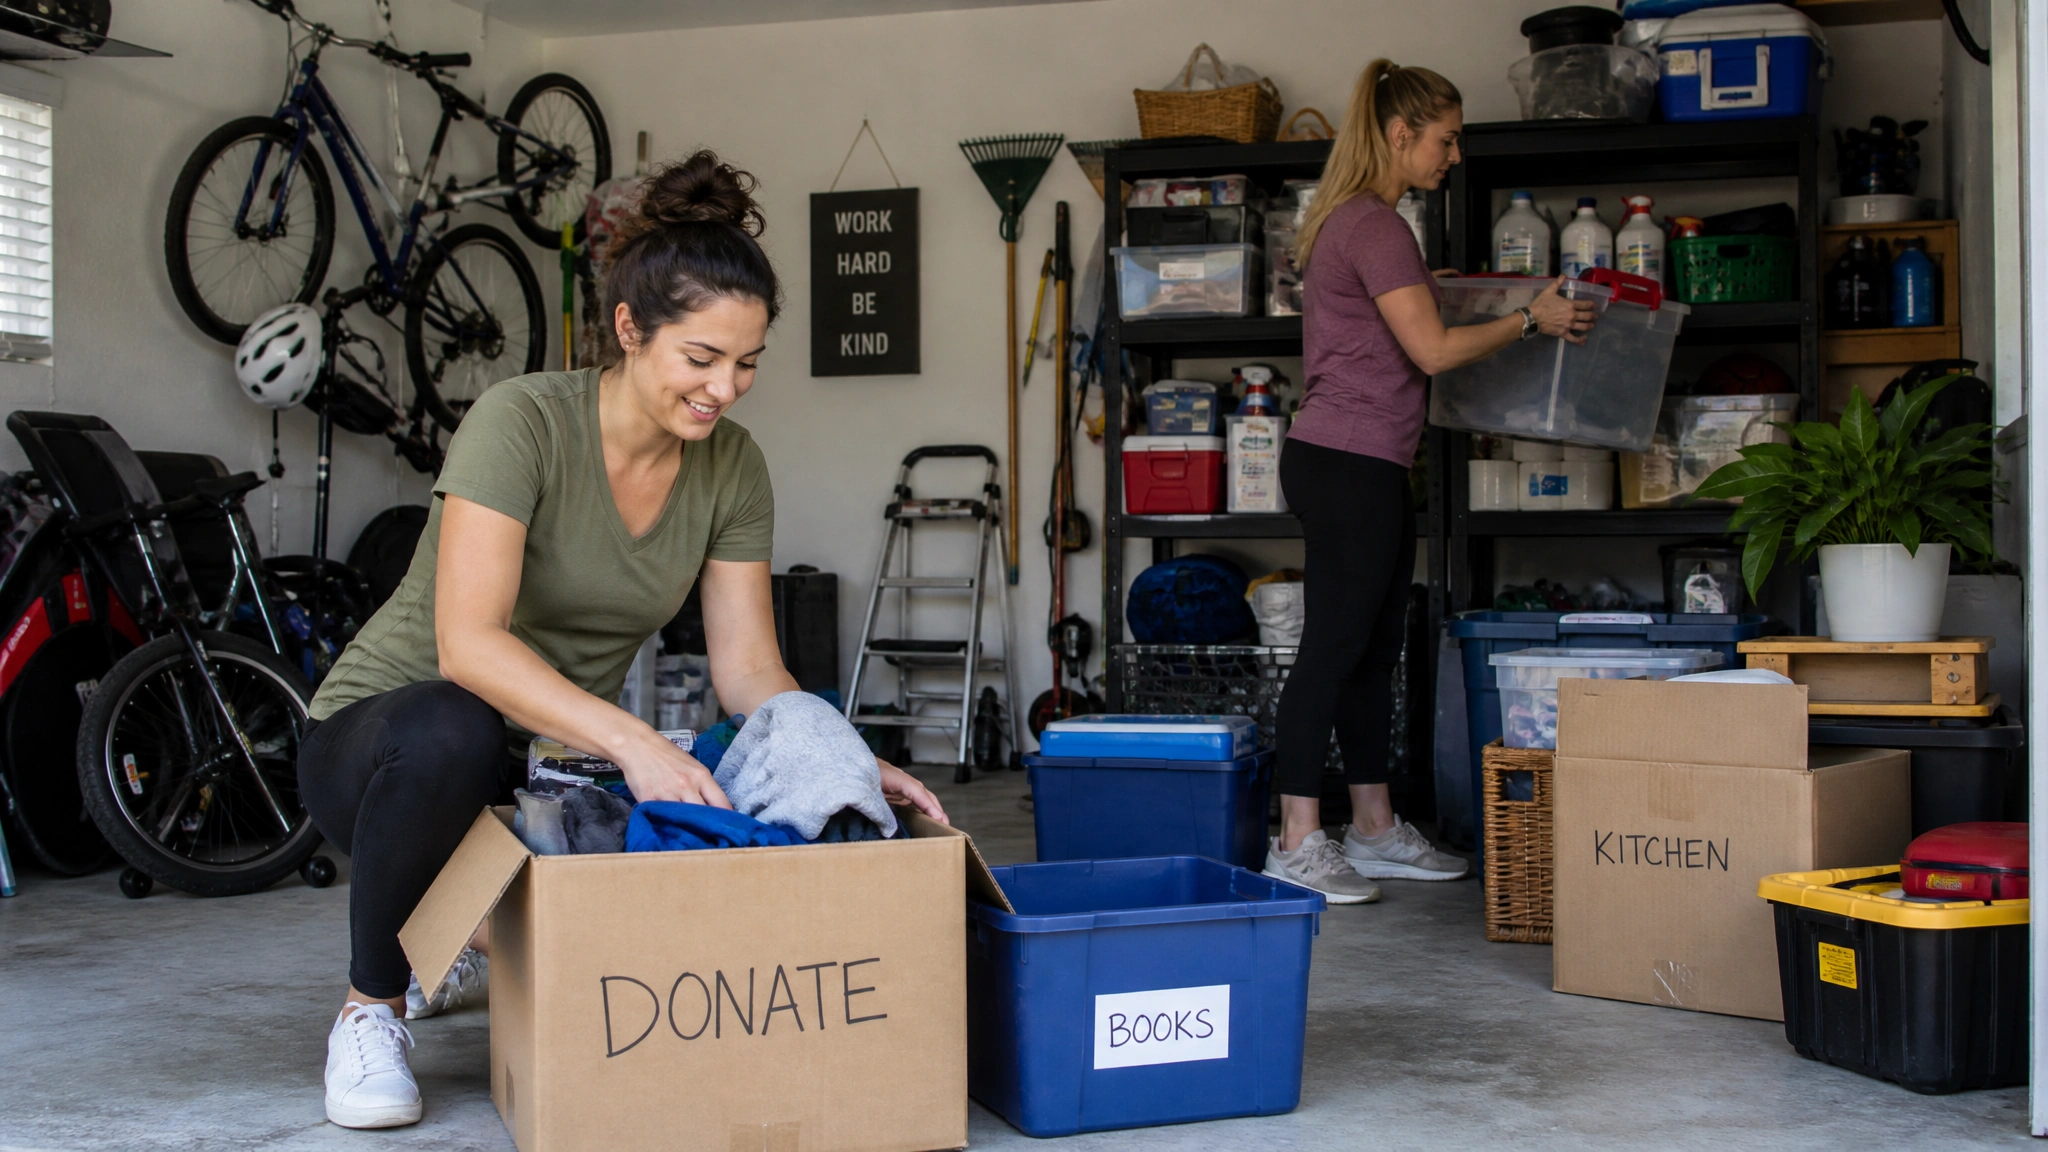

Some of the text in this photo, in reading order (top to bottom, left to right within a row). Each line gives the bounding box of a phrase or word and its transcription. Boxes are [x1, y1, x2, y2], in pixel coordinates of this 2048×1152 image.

[834, 209, 893, 234] WORK
[837, 251, 892, 276] HARD
[852, 291, 877, 315] BE
[840, 332, 889, 357] KIND
[1594, 829, 1729, 872] KITCHEN
[599, 957, 888, 1059] DONATE
[1108, 1008, 1214, 1049] BOOKS
